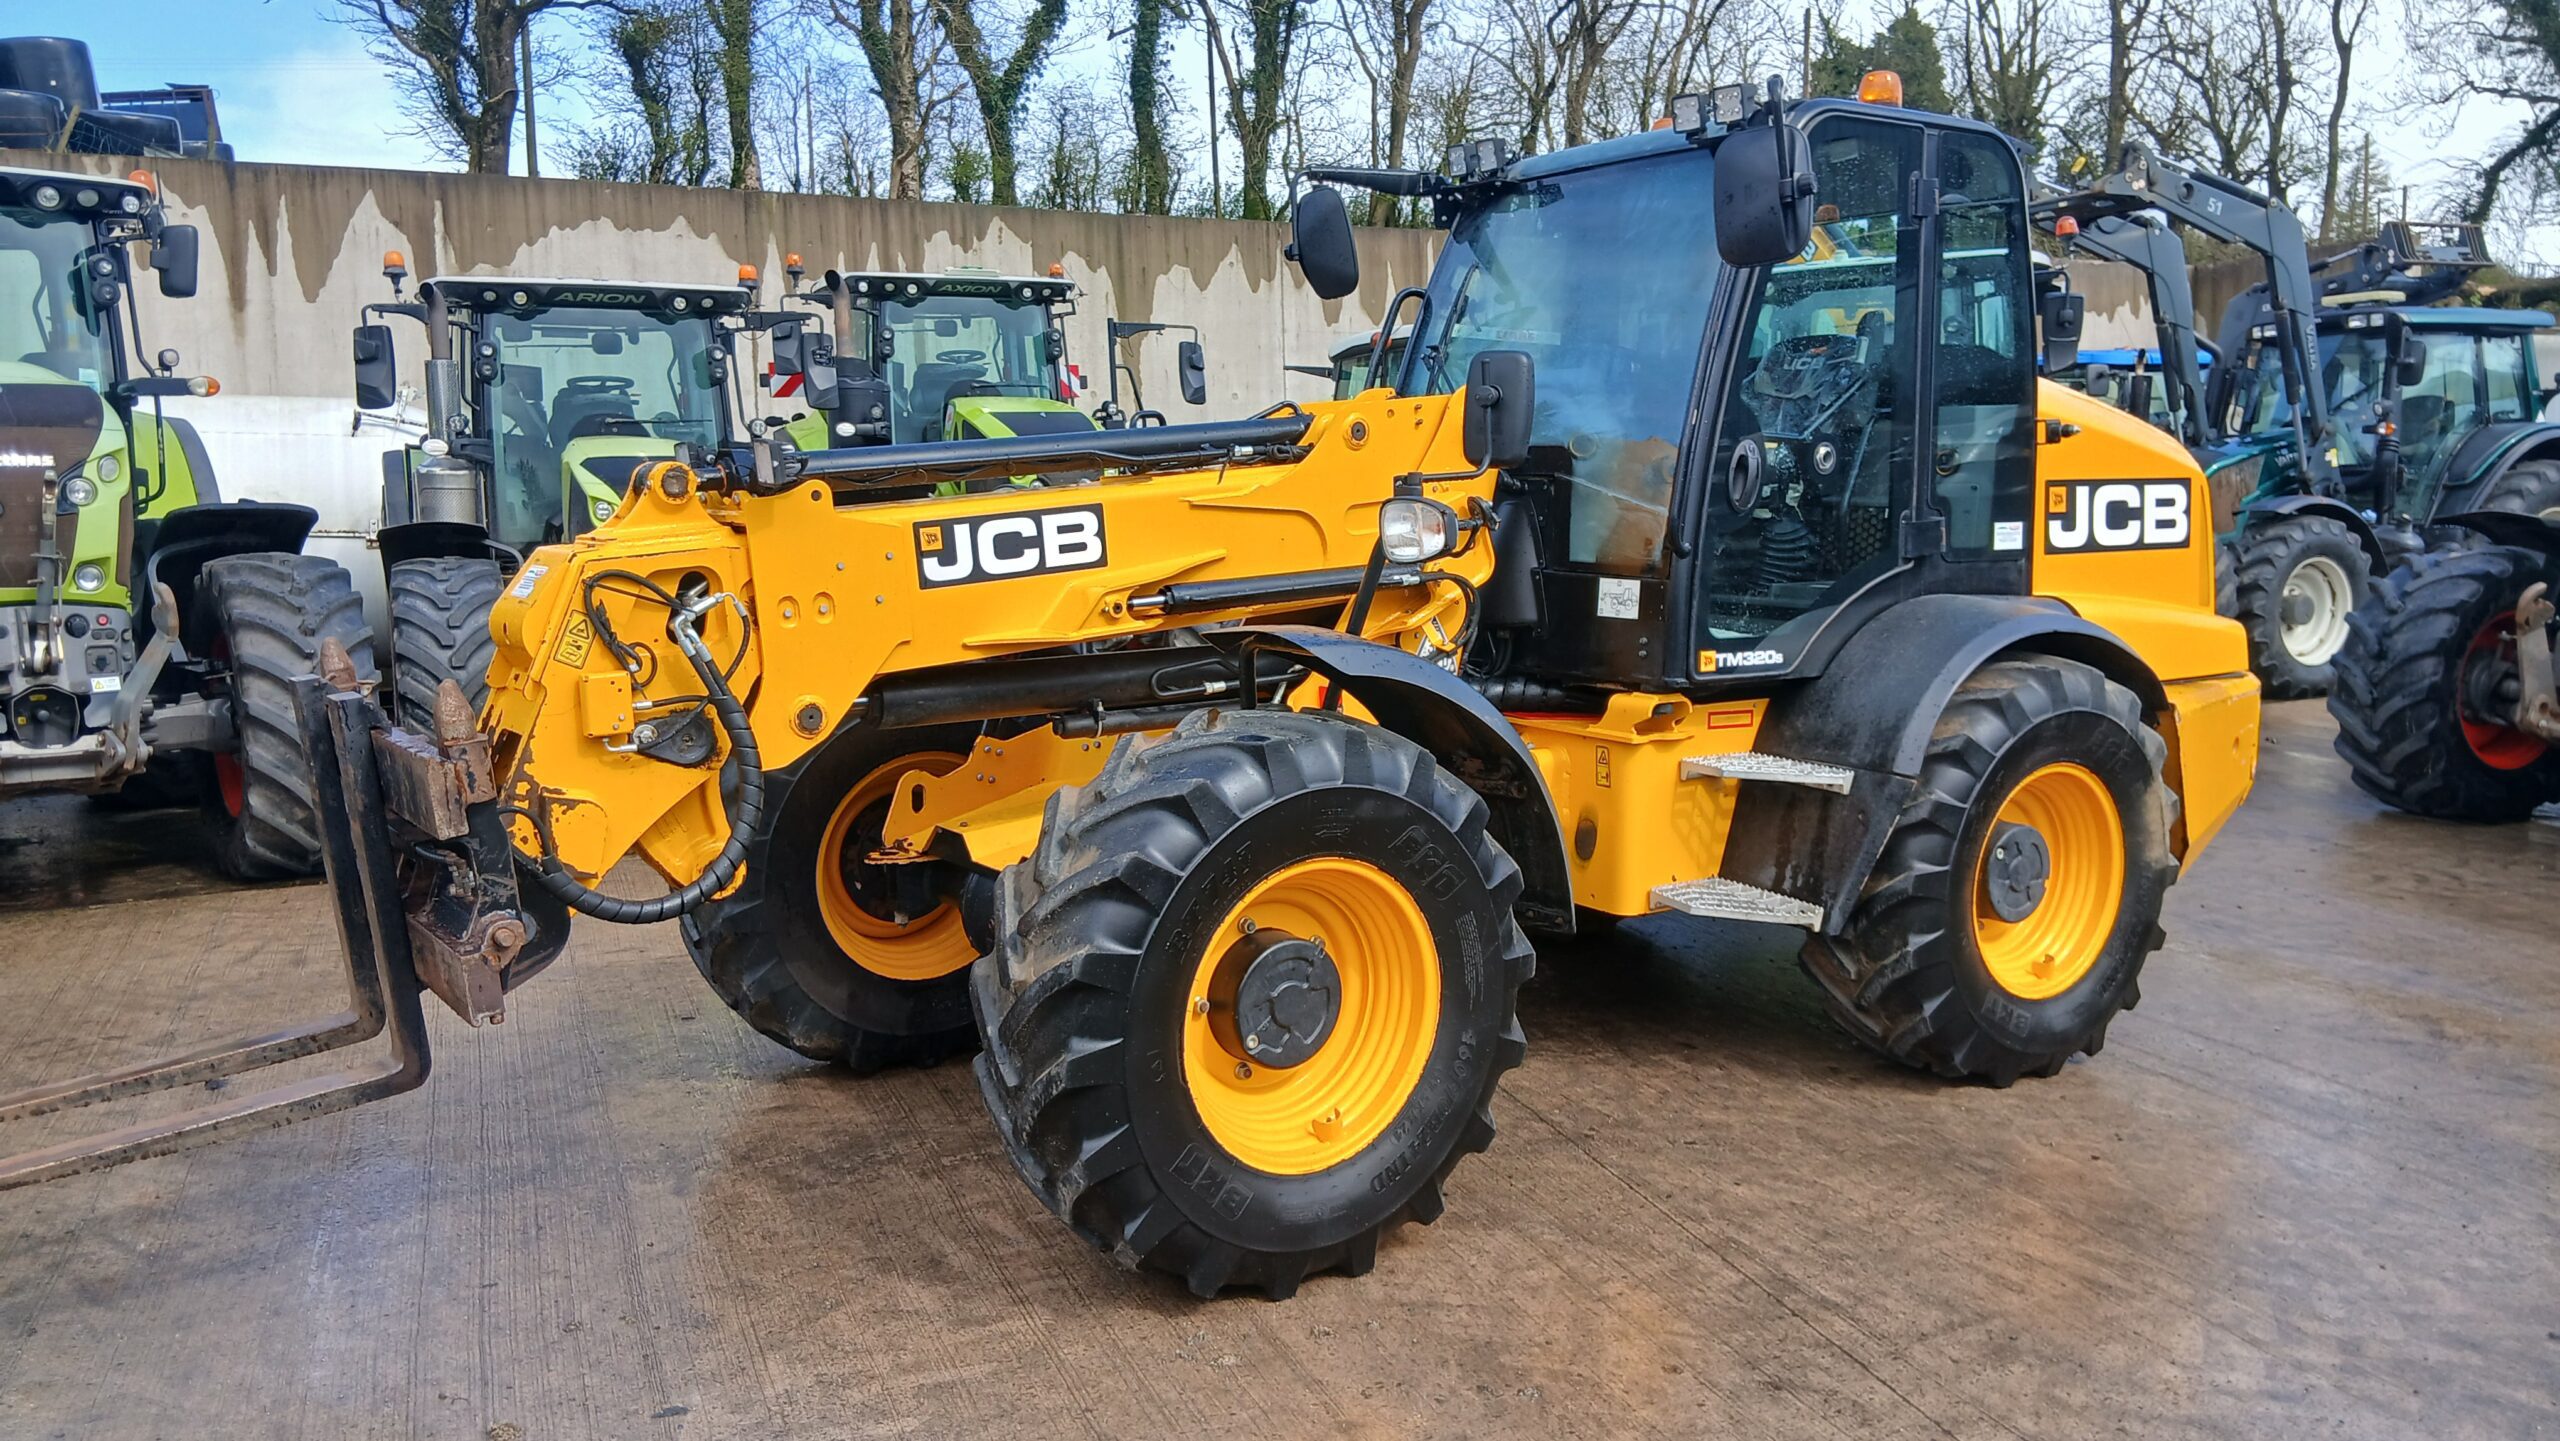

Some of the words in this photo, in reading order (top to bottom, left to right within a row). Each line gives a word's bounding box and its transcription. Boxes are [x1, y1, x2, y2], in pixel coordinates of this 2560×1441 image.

[2207, 197, 2223, 216] 51
[938, 284, 1003, 293] AXION
[554, 292, 646, 304] ARION
[2048, 484, 2188, 548] JCB
[922, 510, 1103, 582] JCB
[1716, 650, 1784, 668] TM320s
